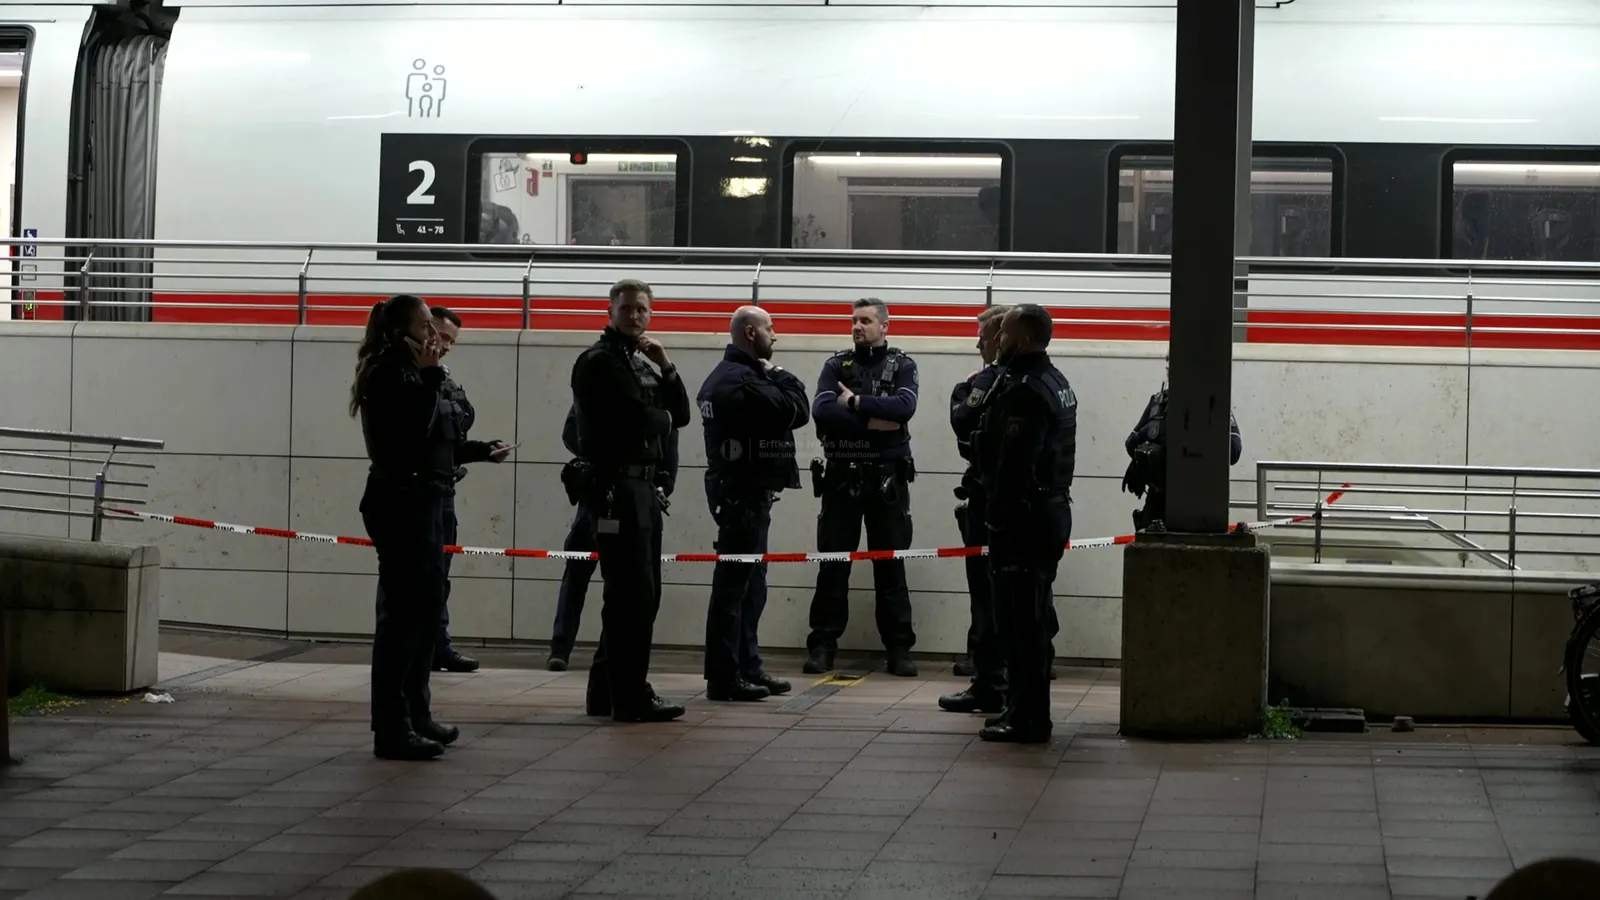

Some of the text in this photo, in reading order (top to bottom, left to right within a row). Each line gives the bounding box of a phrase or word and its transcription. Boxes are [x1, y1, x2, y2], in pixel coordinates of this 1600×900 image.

[406, 159, 436, 205] 2
[417, 225, 427, 234] 41
[434, 225, 444, 235] 78
